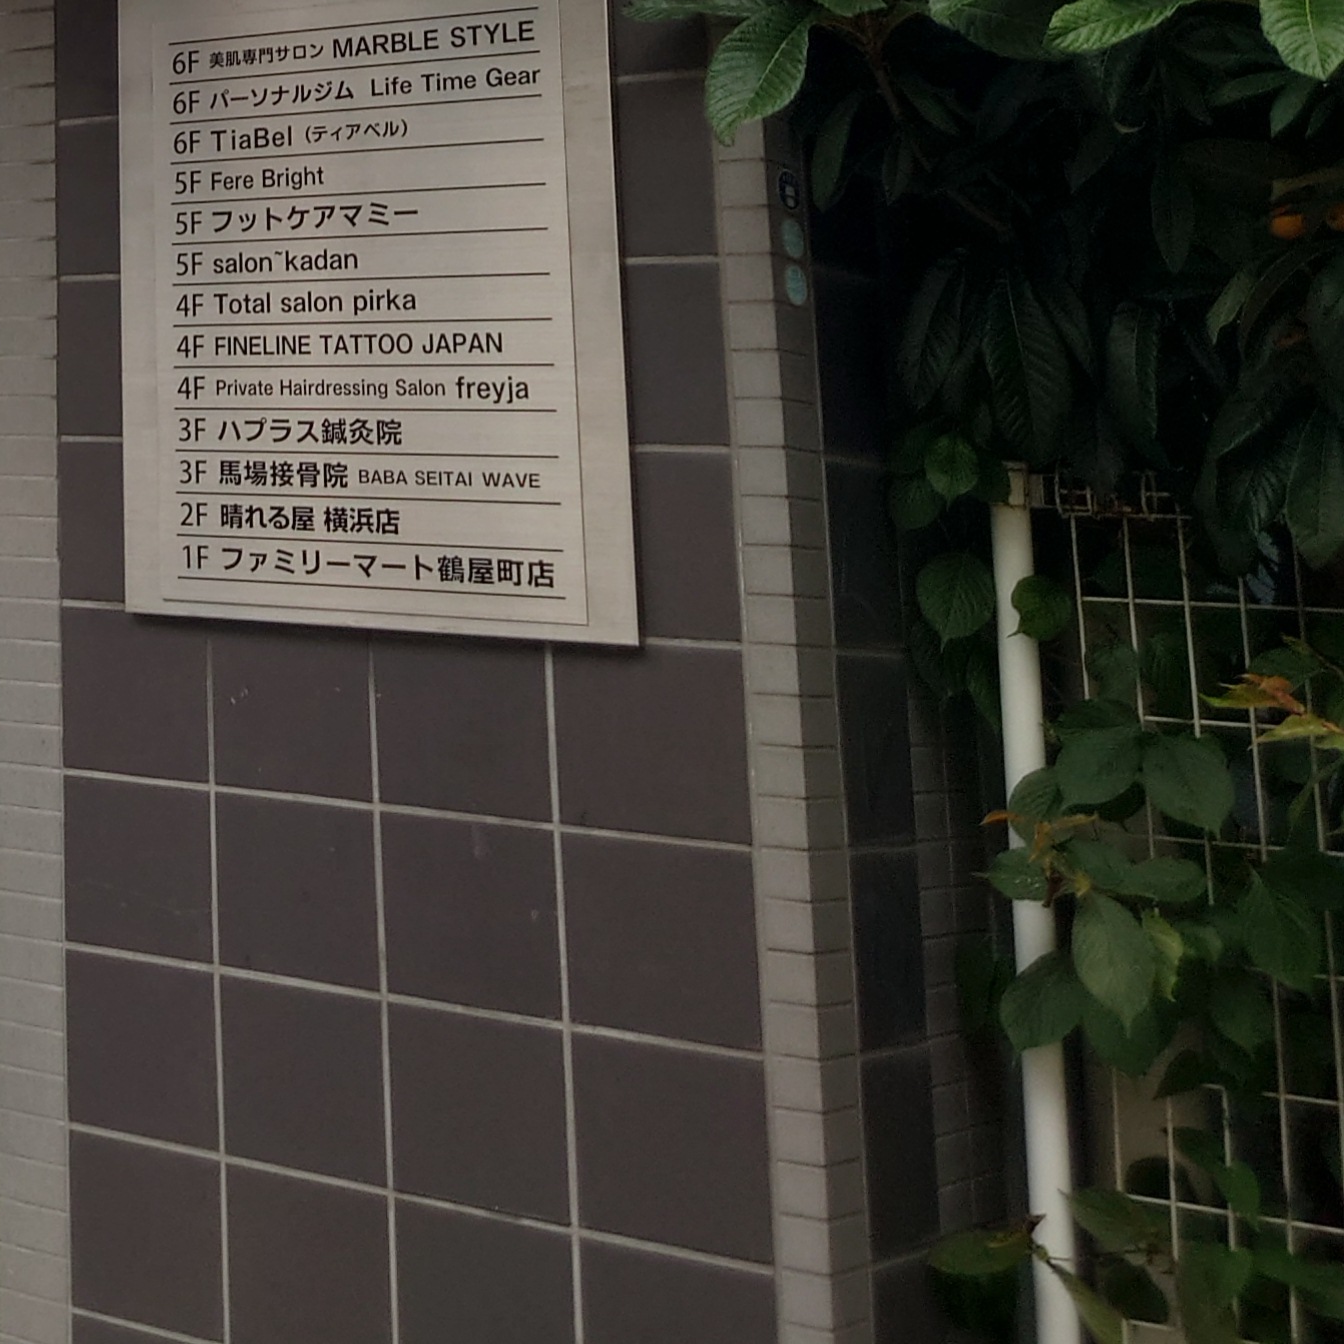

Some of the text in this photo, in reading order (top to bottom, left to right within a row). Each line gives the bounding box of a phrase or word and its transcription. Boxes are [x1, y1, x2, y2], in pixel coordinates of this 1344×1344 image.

[172, 20, 535, 76] 6F 美肌専門サロン MARBLE STYLE
[173, 65, 540, 115] 6F パーソナルジム Life Time Gear
[173, 129, 202, 155] 6F
[211, 125, 294, 152] TiaBel
[174, 166, 325, 195] 5F Fere Bright
[175, 203, 418, 236] 5F フットケアマミー
[175, 252, 204, 277] 5F
[175, 289, 418, 317] 4F Total salon pirka
[176, 332, 503, 358] 4F FINELINE TATTOO JAPAN
[176, 376, 530, 405] 4F Private Hairdressing Salon freyja
[178, 418, 206, 442] 3F
[179, 461, 541, 489] 3F 馬場接骨院 BABA SEITAI WAVE
[180, 503, 400, 536] 2F 晴れる屋 横浜店
[181, 545, 555, 589] 1F ファミリーマート鶴屋町店
